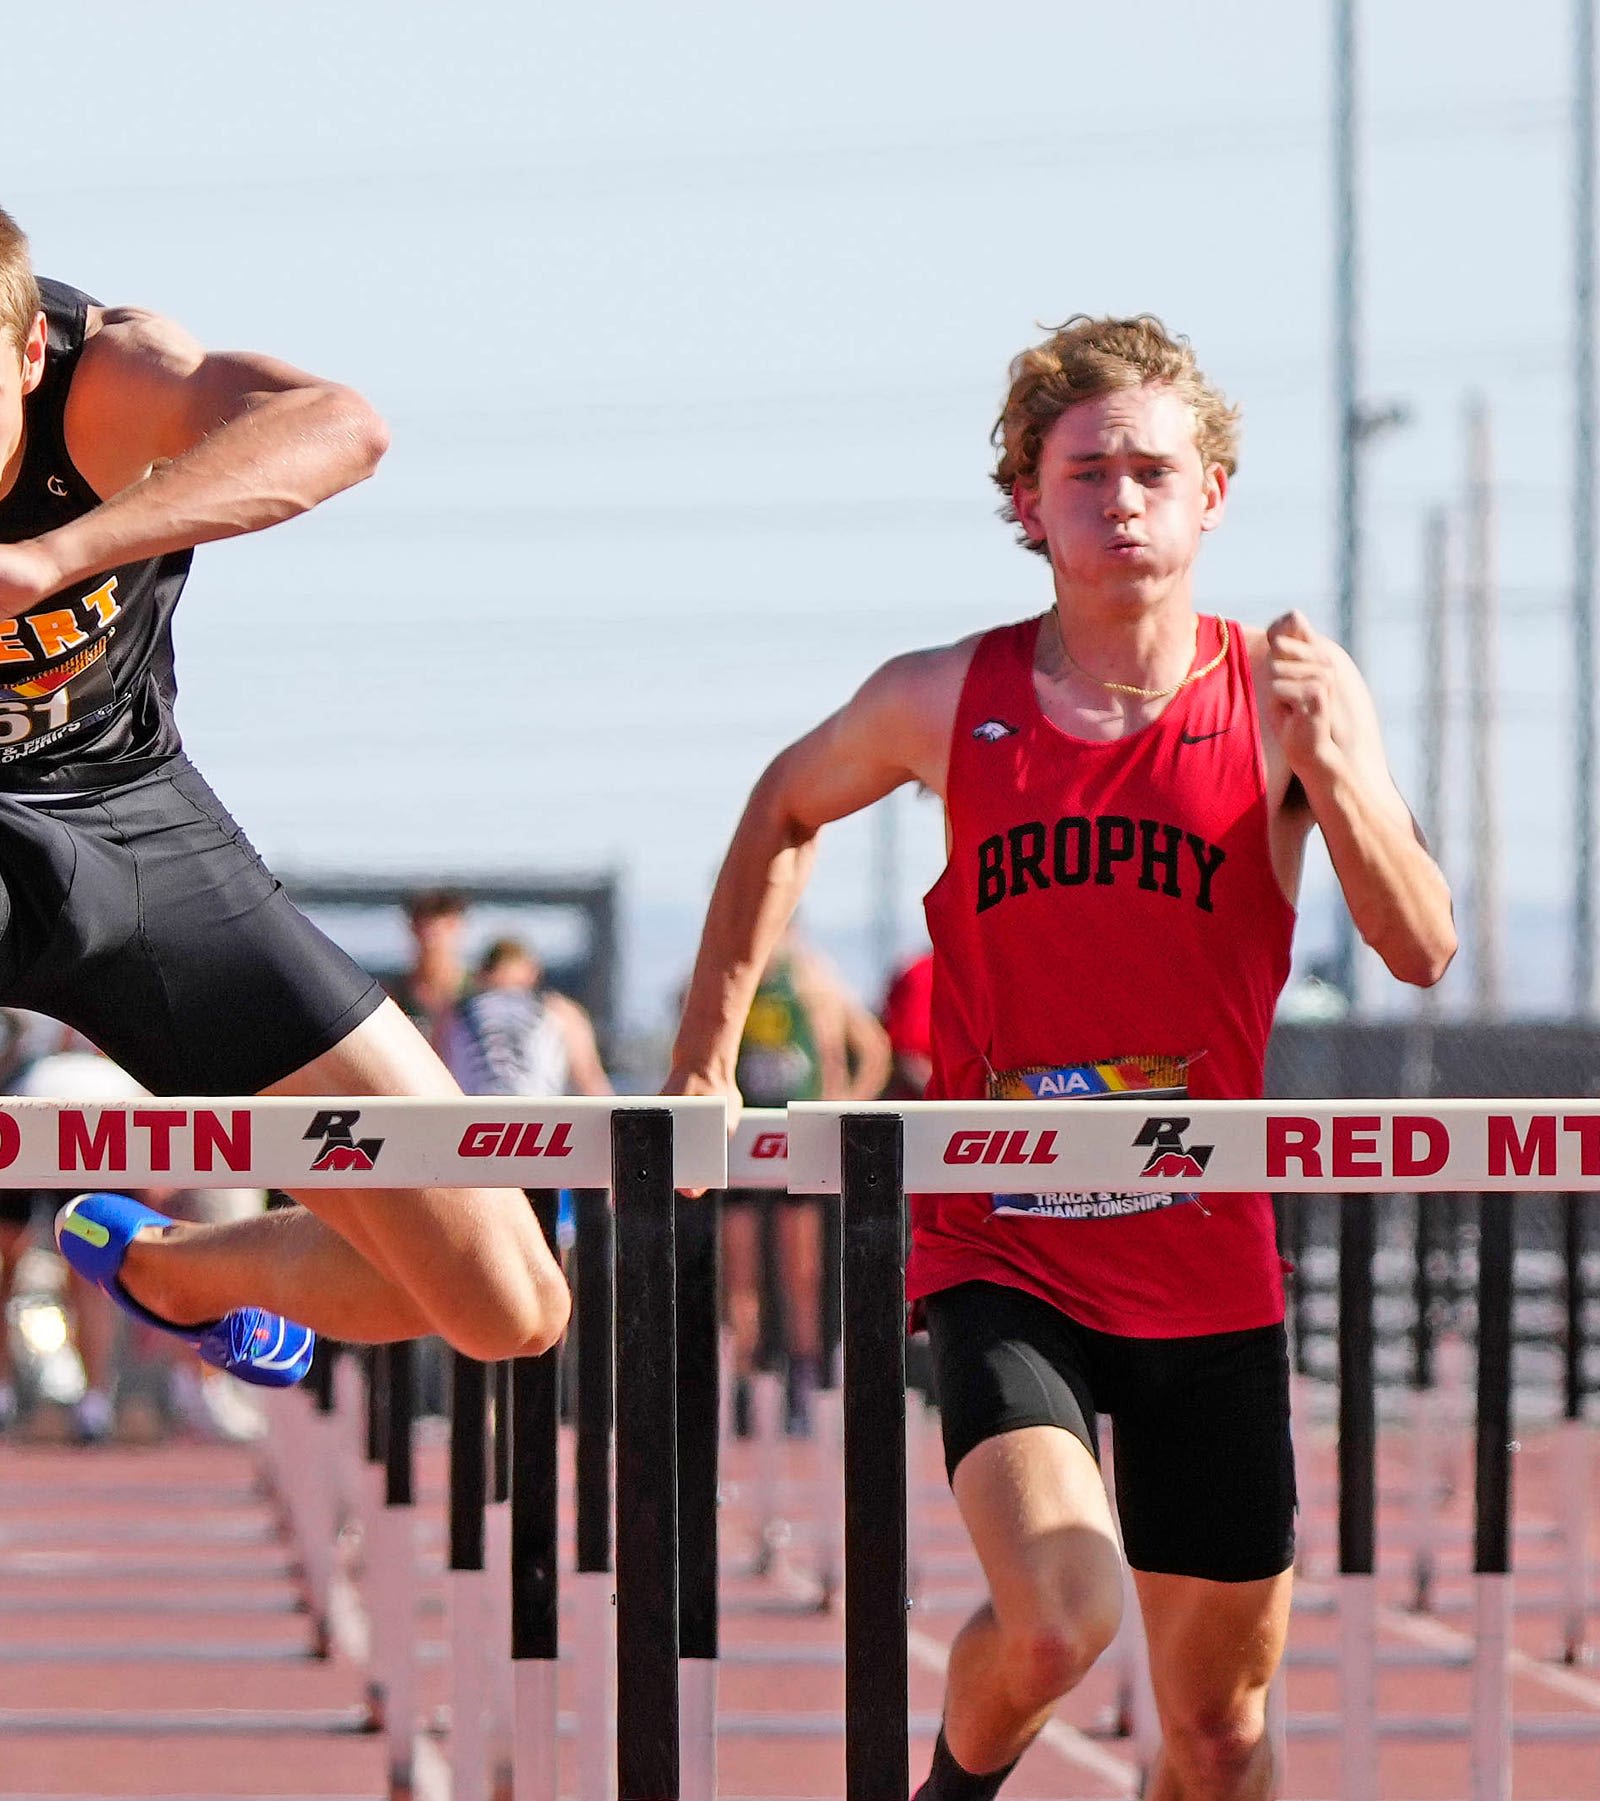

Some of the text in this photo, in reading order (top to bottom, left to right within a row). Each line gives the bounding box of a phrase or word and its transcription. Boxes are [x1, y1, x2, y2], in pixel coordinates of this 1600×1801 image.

[976, 816, 1227, 914] BROPHY
[1037, 1072, 1090, 1097] AIA
[58, 1110, 252, 1171] MTN
[457, 1123, 574, 1157] GILL
[943, 1130, 1059, 1165] GILL
[1266, 1115, 1600, 1178] RED MT
